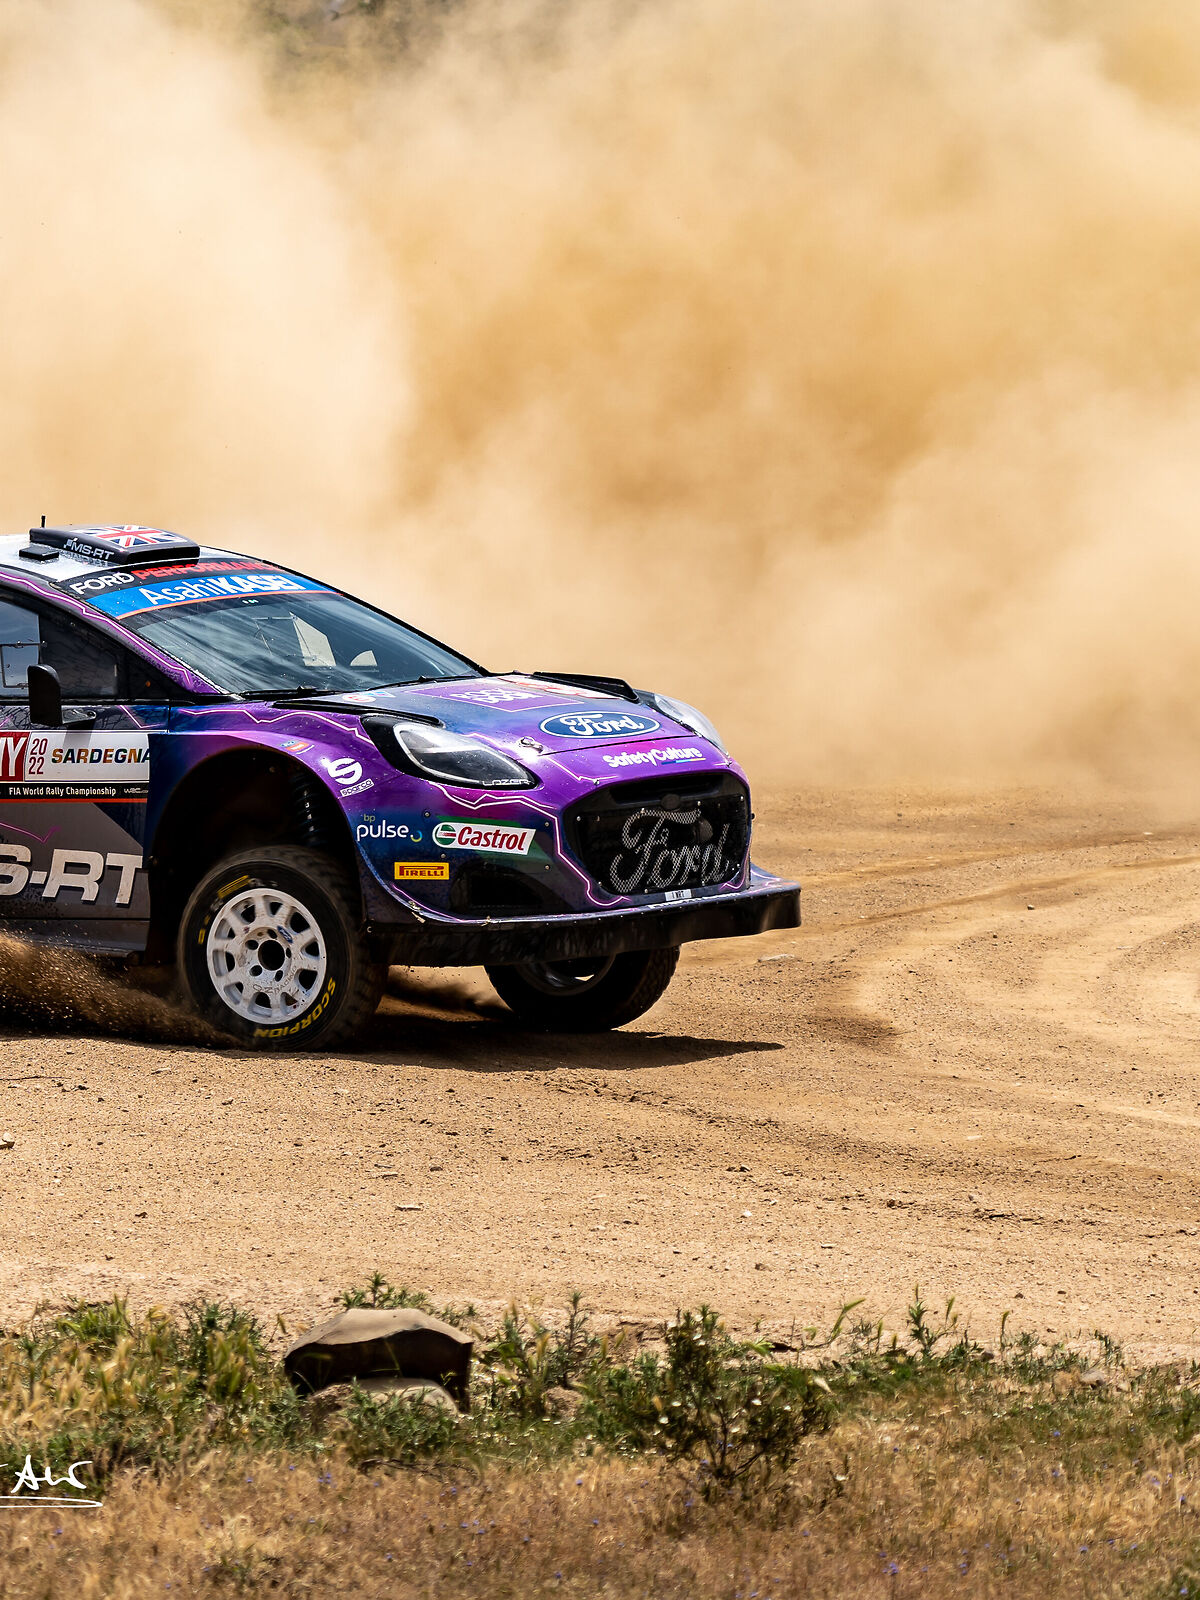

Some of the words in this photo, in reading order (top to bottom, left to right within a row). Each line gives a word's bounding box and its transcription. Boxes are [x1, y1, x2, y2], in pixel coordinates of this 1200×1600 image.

[69, 572, 134, 596] FORD
[141, 575, 307, 605] AsahiKASEI
[559, 714, 644, 735] Ford
[30, 738, 48, 755] 20
[51, 748, 150, 764] SARDEGNA
[28, 756, 45, 775] 22
[602, 747, 703, 768] SafetyCulture
[8, 787, 21, 795] FIA
[22, 786, 44, 796] World
[45, 786, 64, 797] Rally
[65, 786, 117, 797] Championship
[341, 781, 374, 796] sparco
[363, 813, 376, 823] bp
[357, 819, 409, 842] pulse
[457, 826, 528, 850] Castrol
[609, 809, 732, 893] Ford
[399, 865, 445, 877] PIRELLI
[253, 977, 336, 1038] SCORPION
